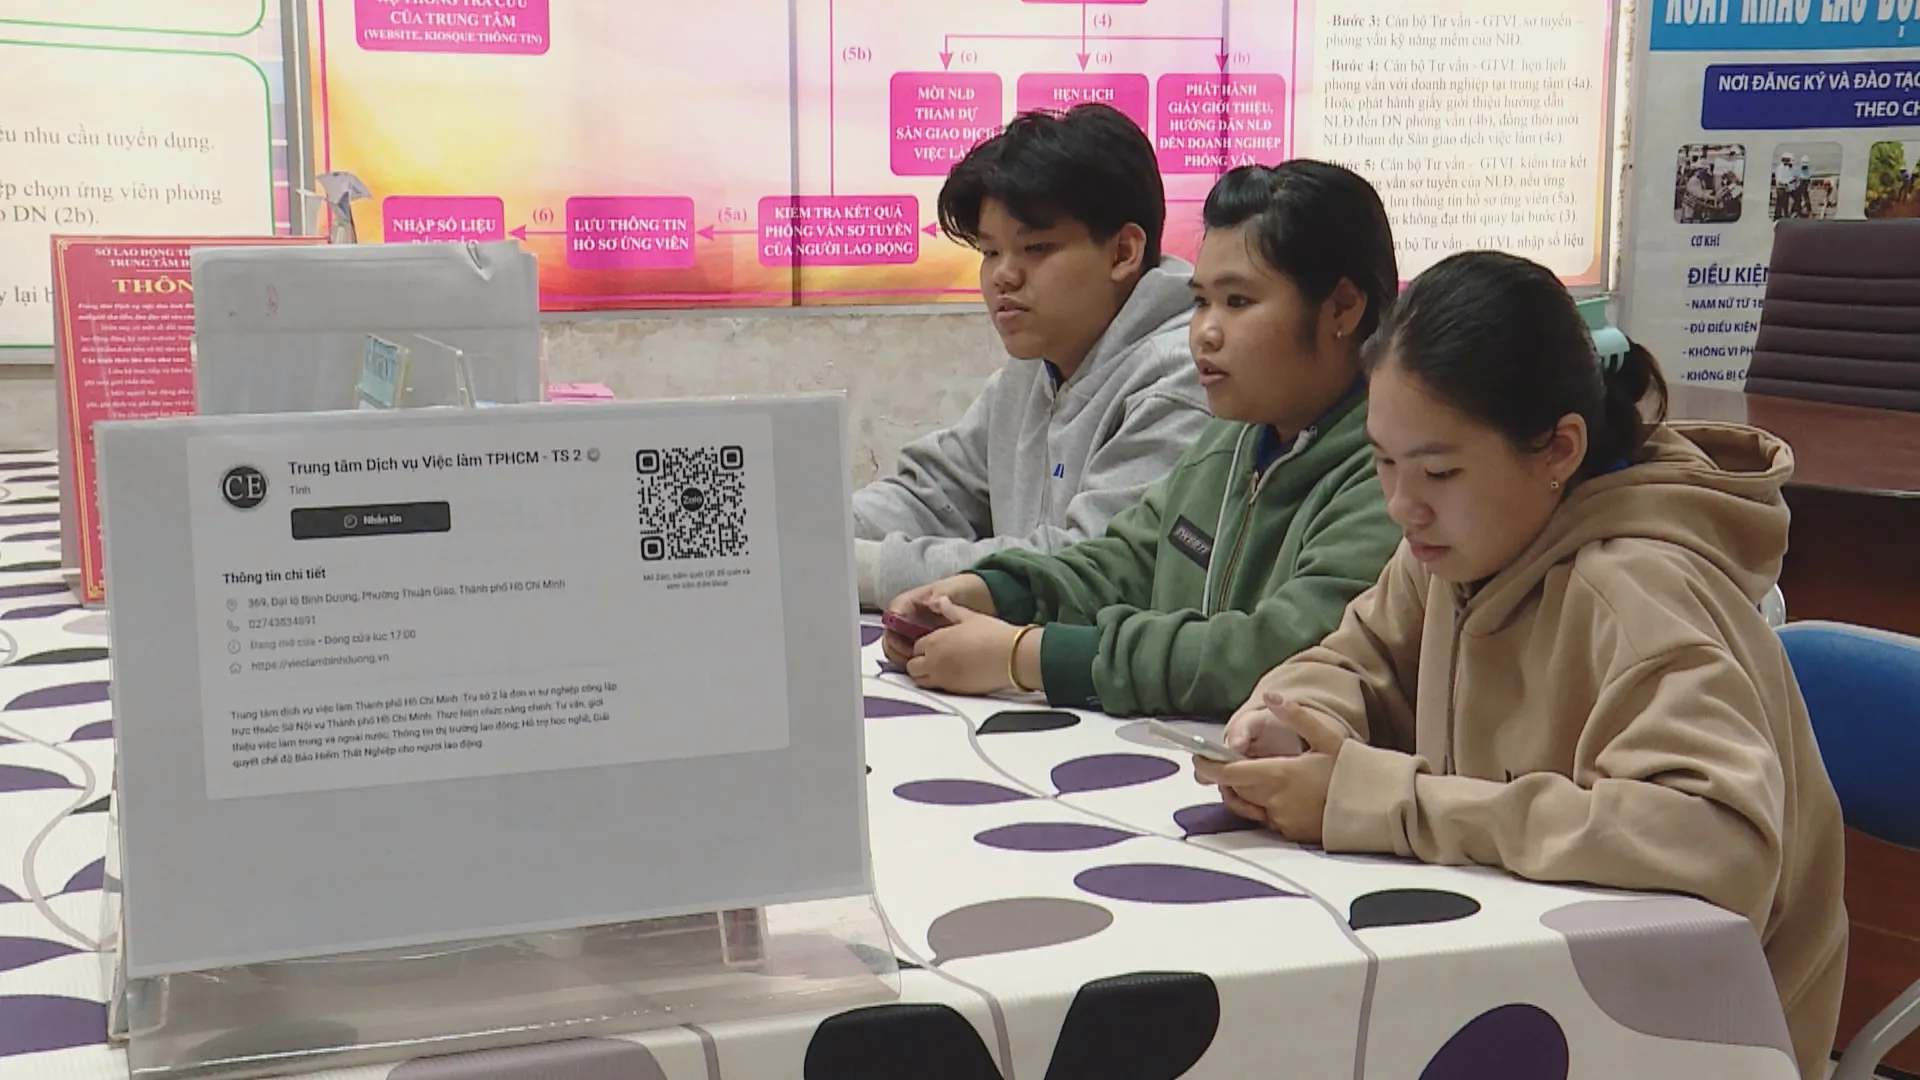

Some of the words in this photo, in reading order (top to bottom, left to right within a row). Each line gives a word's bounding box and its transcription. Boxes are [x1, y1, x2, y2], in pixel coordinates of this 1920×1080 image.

[390, 10, 423, 24] CỦA
[426, 13, 479, 26] TRUNG
[482, 11, 517, 28] TÂM
[1093, 13, 1112, 29] (4)
[1369, 14, 1380, 27] 3:
[425, 30, 475, 43] KIOSQUE
[478, 29, 517, 43] THÔNG
[519, 31, 543, 45] TIN)
[842, 47, 873, 63] (5b)
[961, 50, 978, 64] (c)
[1096, 51, 1113, 64] (a)
[1186, 80, 1219, 96] PHÁT
[1222, 80, 1257, 96] HÀNH
[1411, 77, 1446, 90] doanh
[1450, 77, 1488, 94] nghiệp
[1510, 79, 1539, 93] trung
[1543, 76, 1564, 90] tâm
[1567, 76, 1593, 92] (4a).
[1719, 74, 1749, 91] NƠI
[1751, 71, 1800, 91] ĐĂNG
[1828, 69, 1850, 89] VÀ
[1854, 69, 1891, 89] ĐÀO
[917, 84, 944, 100] MỜI
[1053, 88, 1080, 102] HẸN
[1083, 88, 1114, 103] LỊCH
[915, 106, 954, 120] THAM
[958, 106, 979, 122] DỰ
[1232, 101, 1274, 116] THIỆU,
[1854, 101, 1899, 118] THEO
[24, 126, 60, 144] nhu
[67, 122, 99, 145] cầu
[107, 125, 157, 150] tuyển
[164, 130, 214, 153] dụng.
[925, 127, 960, 140] GIAO
[1187, 136, 1232, 149] DOANH
[1234, 135, 1281, 151] NGHIỆP
[914, 146, 946, 163] VIỆC
[24, 180, 70, 199] chọn
[77, 181, 113, 202] ứng
[120, 182, 158, 200] viên
[14, 205, 47, 223] DN
[54, 207, 99, 227] (2b).
[532, 207, 554, 224] (6)
[718, 207, 747, 223] (5a)
[814, 207, 842, 219] TRA
[845, 203, 872, 219] KẾT
[392, 218, 435, 235] NHẬP
[437, 216, 457, 232] SỐ
[461, 218, 496, 235] LIỆU
[574, 217, 605, 232] LƯU
[608, 216, 659, 231] THÔNG
[663, 219, 687, 231] TIN
[848, 224, 866, 237] SƠ
[573, 236, 595, 251] HỒ
[599, 237, 617, 251] SƠ
[620, 234, 652, 251] ỨNG
[654, 235, 689, 251] VIÊN
[1691, 235, 1702, 247] CƠ
[1704, 233, 1720, 247] KHÍ
[113, 248, 138, 257] LAO
[764, 241, 793, 256] CỦA
[844, 243, 872, 255] LAO
[875, 241, 913, 257] ĐỘNG
[108, 259, 150, 267] TRUNG
[150, 258, 179, 267] TÂM
[112, 275, 193, 294] THÔN
[14, 285, 37, 306] lại
[1691, 299, 1717, 309] NAM
[1688, 345, 1726, 357] KHÔNG
[1728, 347, 1739, 356] VI
[1687, 369, 1724, 381] KHÔNG
[1726, 371, 1737, 382] BỊ
[288, 459, 330, 476] Trung
[335, 458, 363, 474] tâm
[366, 457, 398, 475] Dịch
[401, 458, 419, 474] vụ
[422, 453, 453, 471] Việc
[456, 452, 482, 468] làm
[485, 451, 539, 467] TPHCM
[552, 449, 570, 463] TS
[573, 449, 582, 462] 2
[224, 473, 266, 501] CE
[222, 572, 262, 586] Thông
[266, 570, 282, 582] tin
[285, 568, 303, 581] chi
[306, 565, 326, 580] tiết
[460, 583, 488, 595] Thành
[490, 581, 508, 595] phố
[510, 580, 524, 592] Hồ
[543, 578, 565, 590] Minh
[231, 709, 258, 721] Trung
[260, 708, 279, 719] tâm
[280, 706, 301, 718] dịch
[302, 706, 314, 716] vụ
[315, 704, 334, 715] việc
[336, 702, 353, 712] làm
